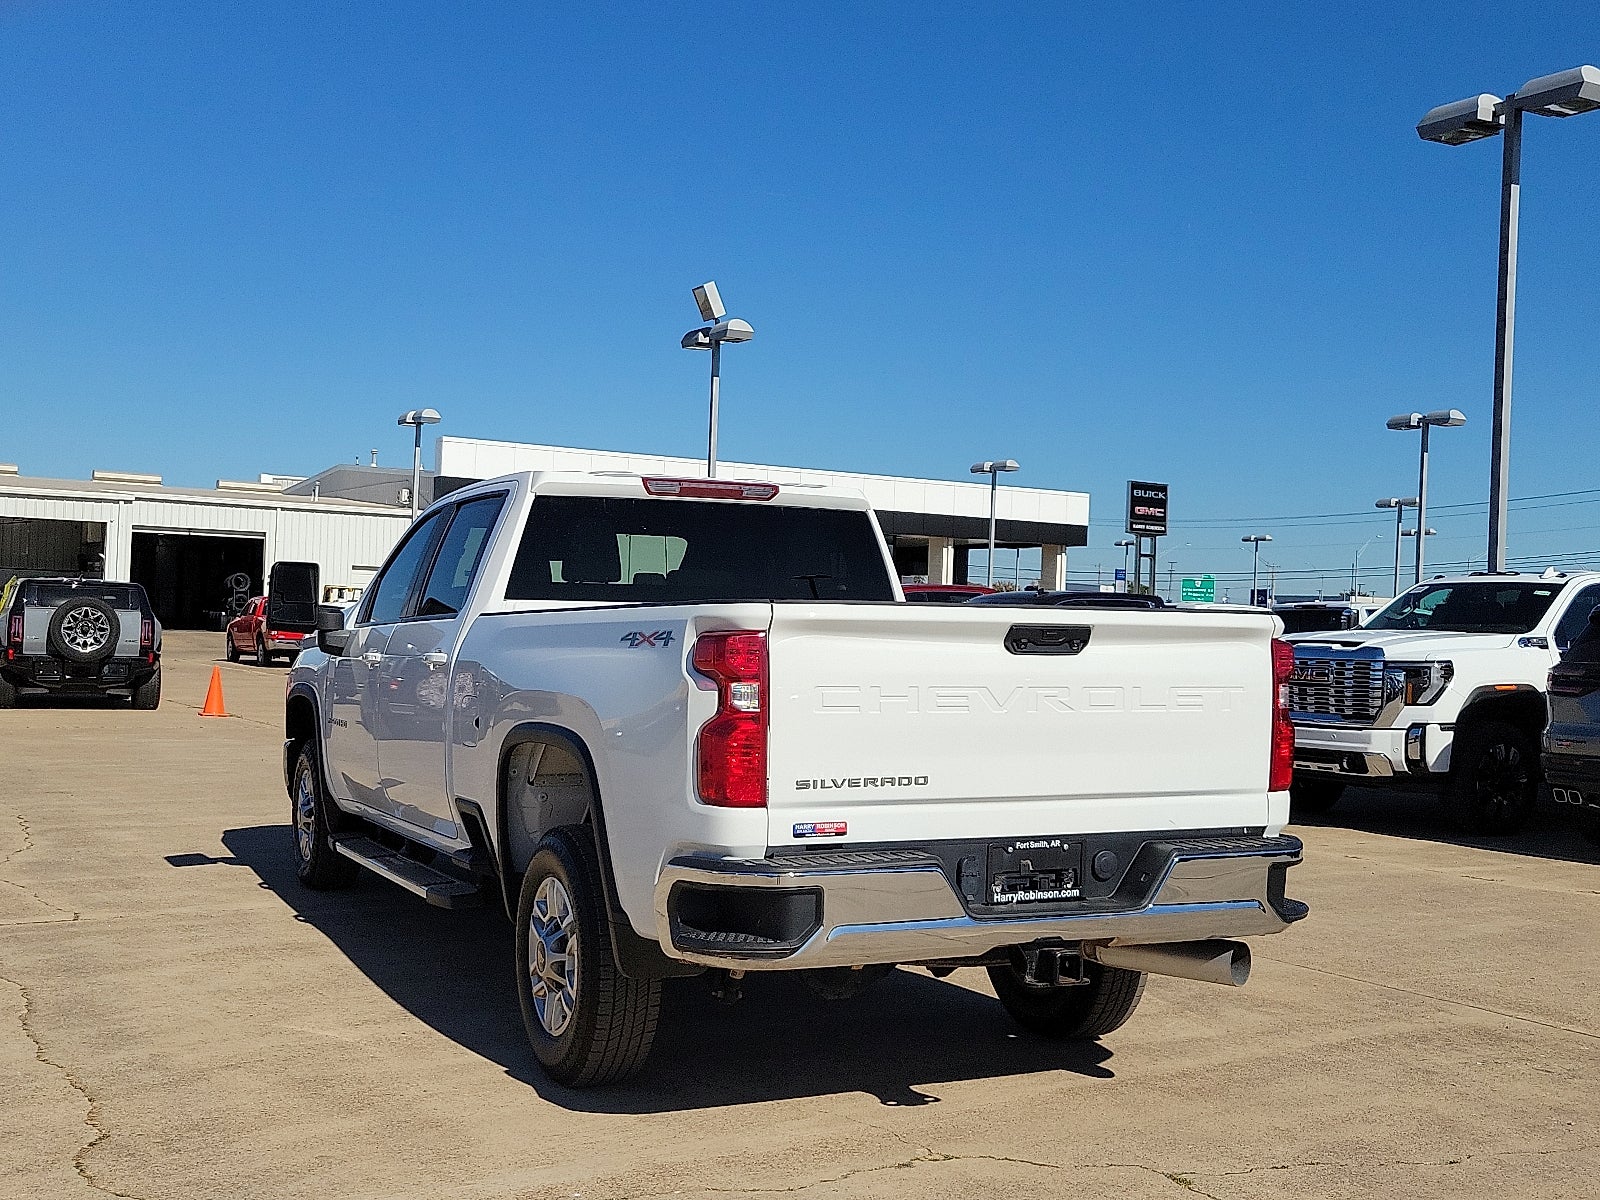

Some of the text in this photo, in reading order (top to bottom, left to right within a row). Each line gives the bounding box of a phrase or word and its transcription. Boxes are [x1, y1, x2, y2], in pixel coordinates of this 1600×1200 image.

[1133, 489, 1166, 499] BUICK
[1134, 506, 1165, 516] GMC
[814, 685, 1246, 714] CHEVROLET
[795, 775, 929, 790] SILVERADO
[1015, 841, 1029, 849] Fort
[1050, 839, 1061, 847] AR
[993, 888, 1080, 903] HarryRobinson.com
